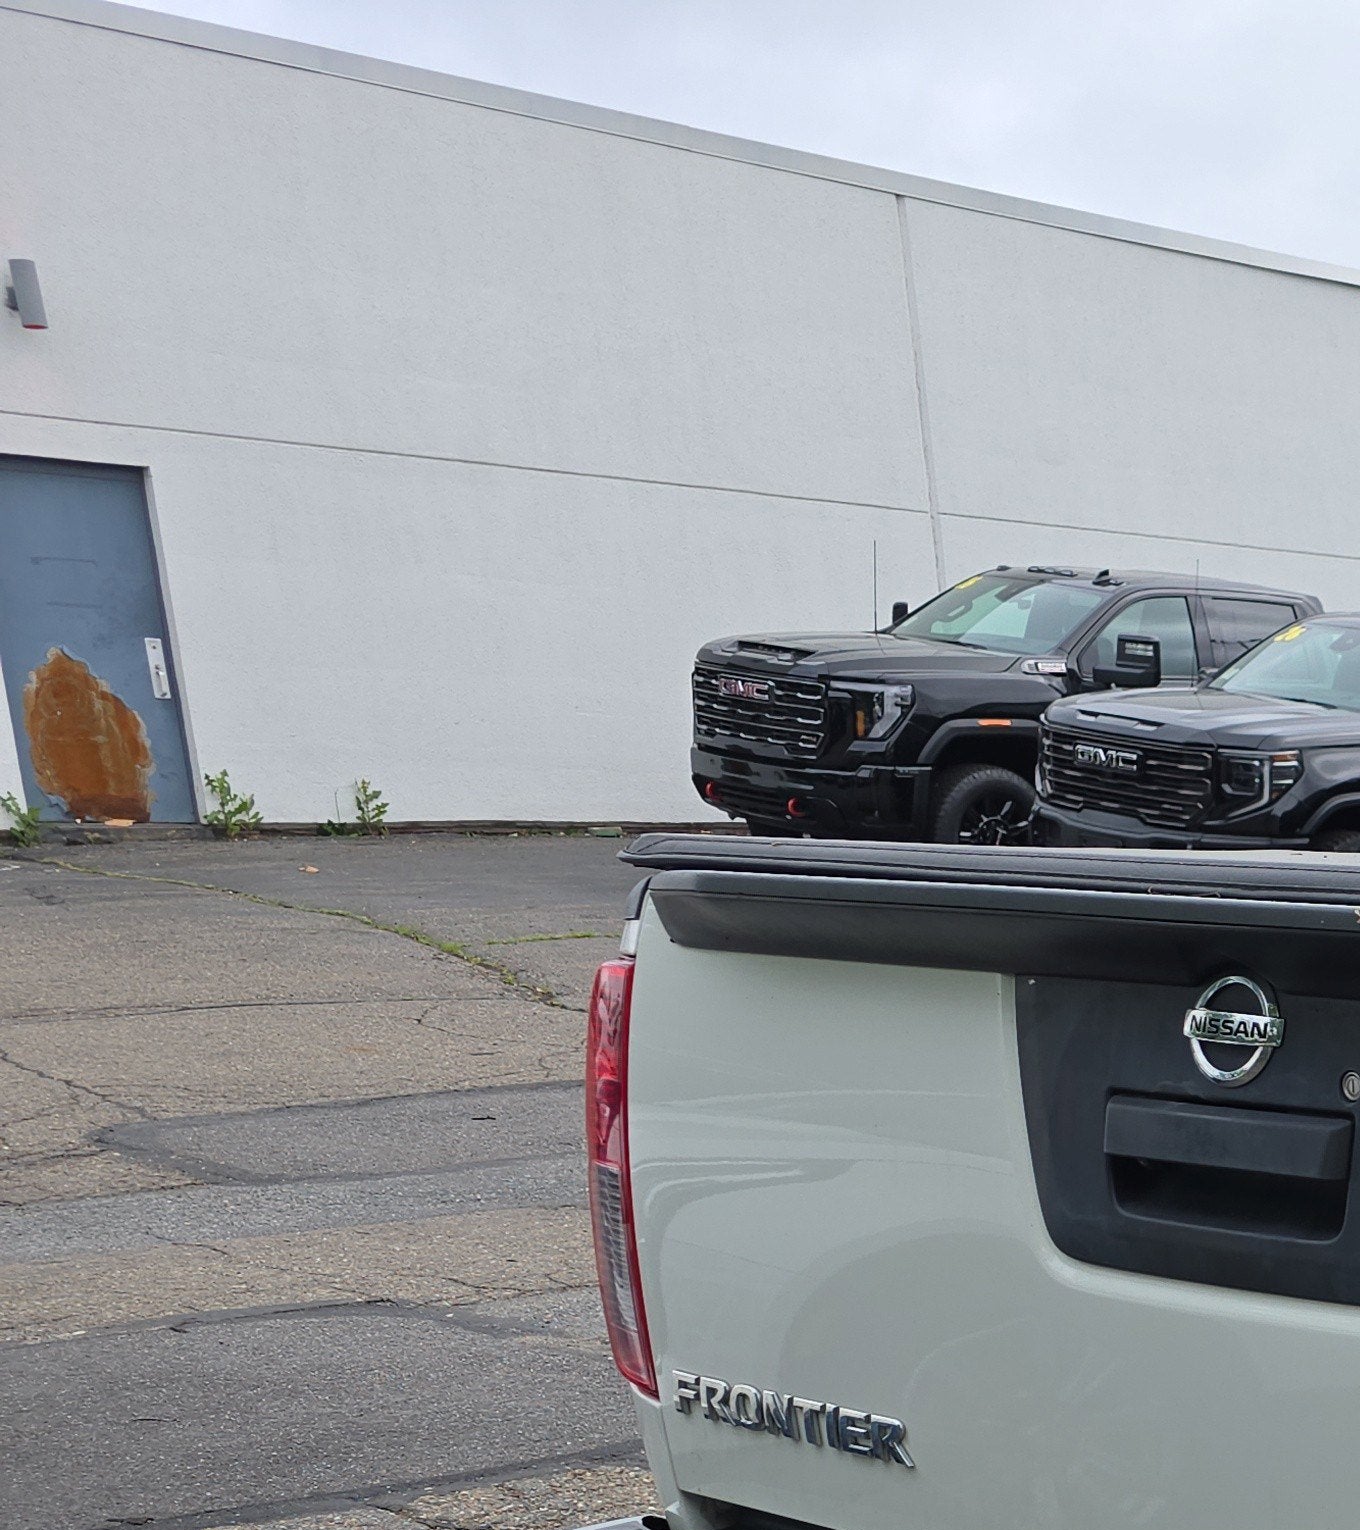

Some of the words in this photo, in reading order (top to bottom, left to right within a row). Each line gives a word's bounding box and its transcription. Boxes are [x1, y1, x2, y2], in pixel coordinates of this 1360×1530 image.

[719, 677, 770, 701] GMC
[1075, 744, 1138, 771] GMC
[1190, 1014, 1269, 1039] NISSAN
[672, 1368, 916, 1469] FRONTIER
